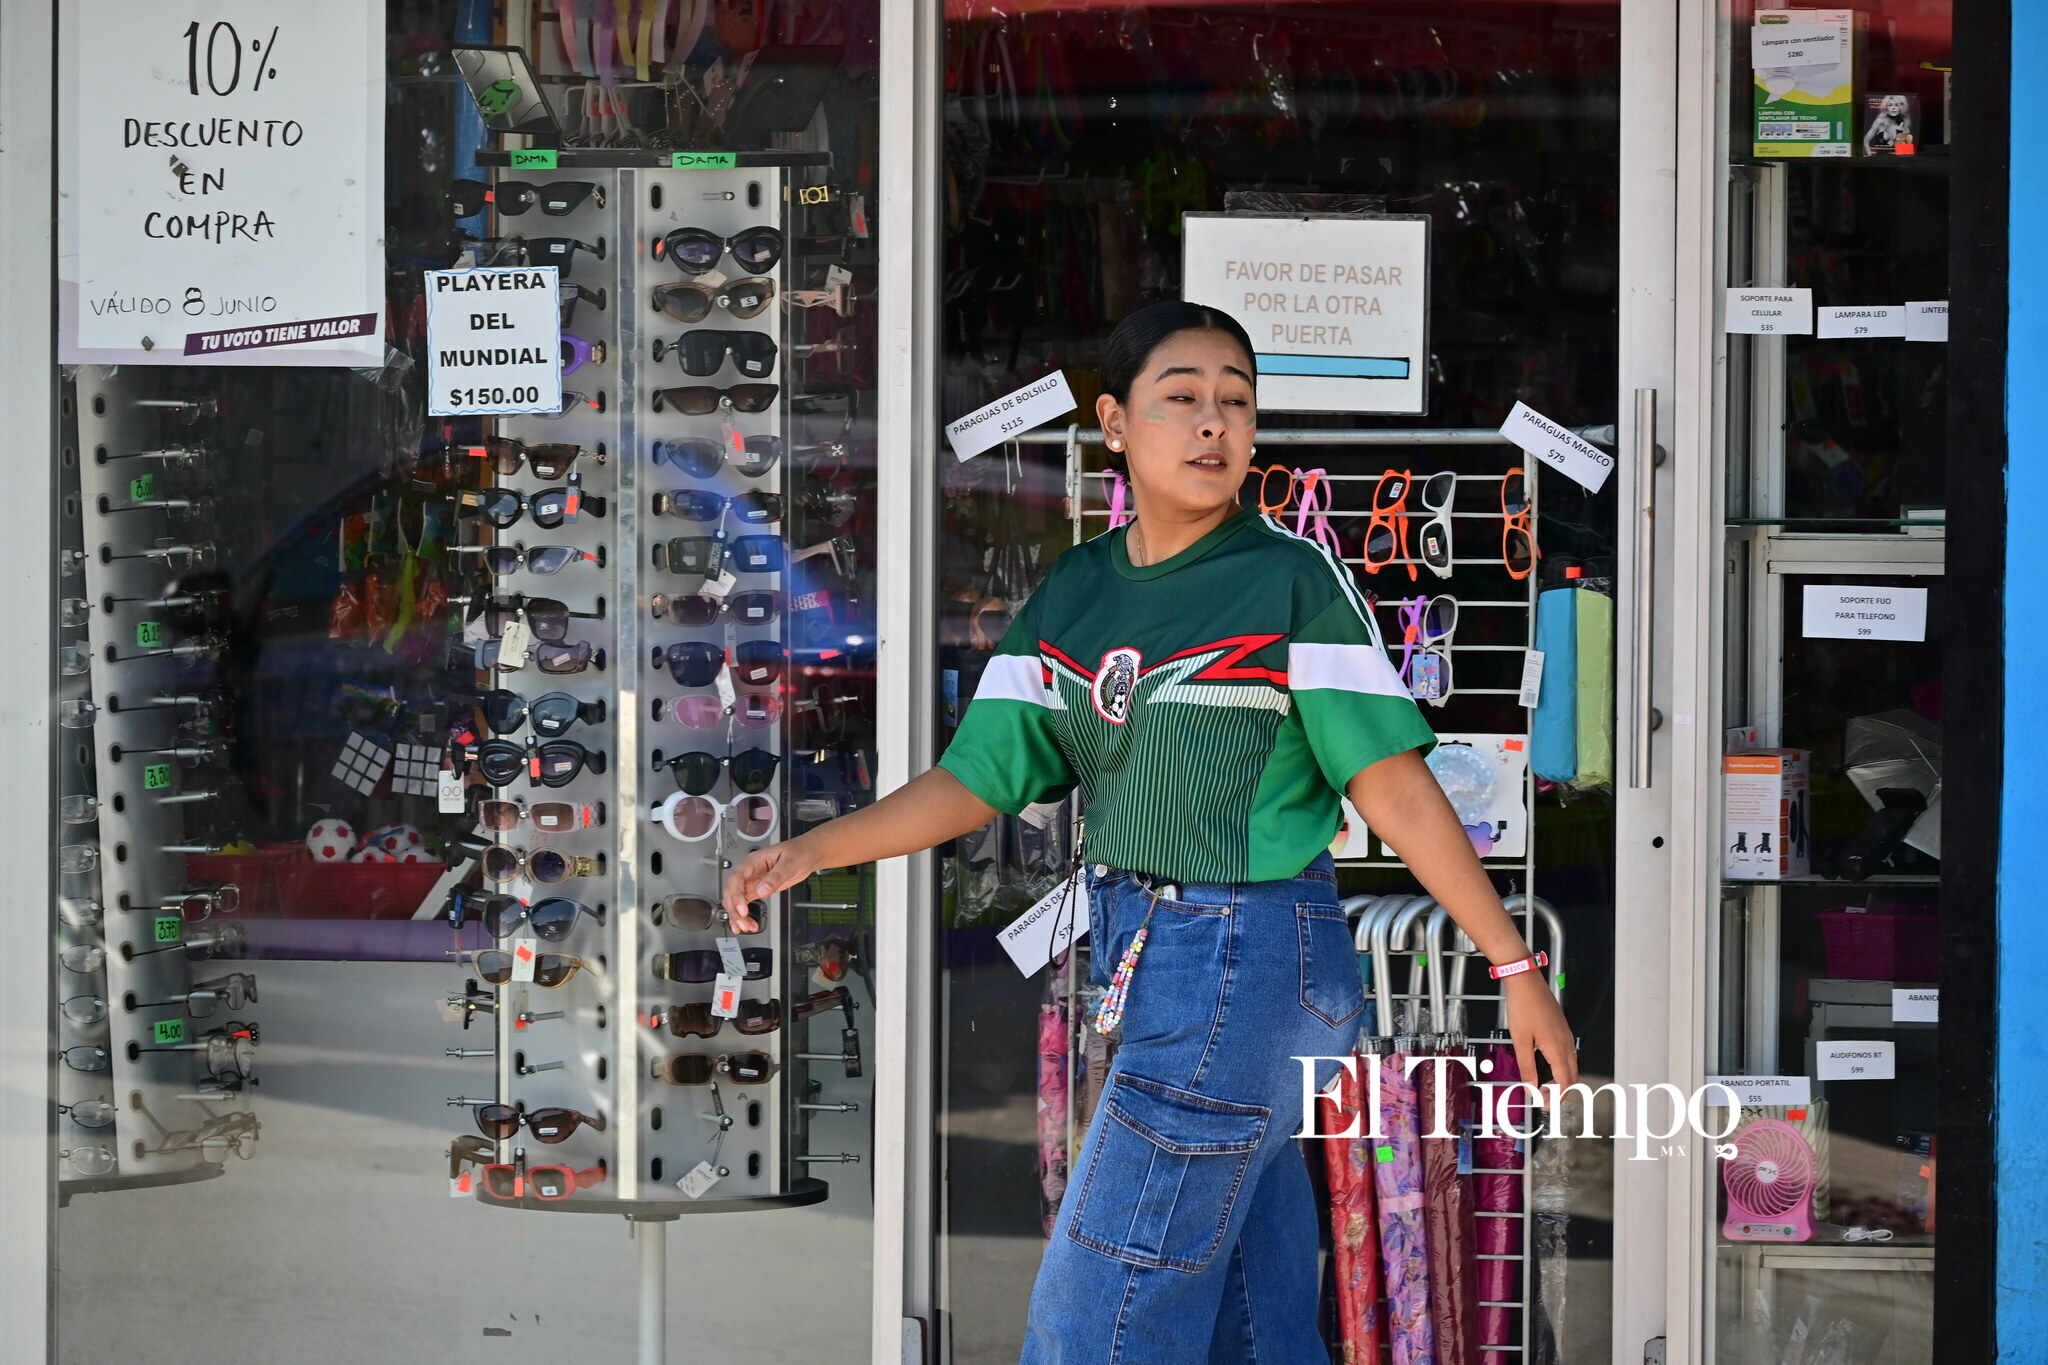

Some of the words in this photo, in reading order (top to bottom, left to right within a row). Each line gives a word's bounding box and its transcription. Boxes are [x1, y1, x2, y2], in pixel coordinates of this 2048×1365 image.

[1762, 38, 1789, 47] Lámpara
[1803, 35, 1836, 43] ventilador
[183, 21, 279, 96] 10%
[123, 117, 304, 149] DESCUENTO
[515, 154, 548, 165] DAMA
[677, 155, 729, 166] DAMA
[180, 168, 225, 196] EN
[144, 210, 275, 244] COMPRA
[1225, 261, 1293, 282] FAVOR
[1300, 263, 1326, 283] DE
[1333, 264, 1403, 286] PASAR
[437, 273, 546, 292] PLAYERA
[90, 291, 171, 316] VÁLIDO
[183, 287, 205, 316] 8
[210, 296, 277, 316] JUNIO
[1244, 292, 1287, 313] POR
[1293, 294, 1320, 314] LA
[1325, 295, 1383, 316] OTRA
[1774, 295, 1793, 303] PARA
[1834, 311, 1872, 319] LAMPARA
[1873, 310, 1887, 318] LED
[1921, 306, 1949, 314] LINTER
[470, 313, 515, 330] DEL
[1760, 324, 1774, 332] $35
[201, 335, 220, 350] TU
[223, 330, 262, 348] VOTO
[265, 325, 306, 343] TIENE
[310, 319, 360, 337] VALOR
[1271, 324, 1353, 346] PUERTA
[1854, 327, 1868, 335] $79
[440, 348, 547, 367] MUNDIAL
[450, 386, 539, 408] $150.00
[953, 405, 1001, 435] PARAGUAS
[1001, 399, 1015, 411] DE
[1015, 378, 1058, 405] BOLSILLO
[1000, 416, 1024, 433] $115
[1522, 411, 1572, 445] PARAGUAS
[1571, 440, 1610, 467] MAGICO
[1547, 449, 1566, 464] $79
[1840, 596, 1874, 605] SOPORTE
[1876, 597, 1892, 605] FIJO
[1835, 612, 1855, 620] PARA
[1857, 612, 1896, 621] TELEFONO
[1858, 628, 1872, 636] $99
[1008, 902, 1052, 940] PARAGUAS
[1051, 891, 1064, 905] DE
[158, 921, 177, 941] 3.75
[1500, 962, 1527, 975] MEXICO
[160, 1024, 182, 1040] 4.00
[1851, 1066, 1864, 1074] $99
[1748, 1095, 1762, 1103] $55
